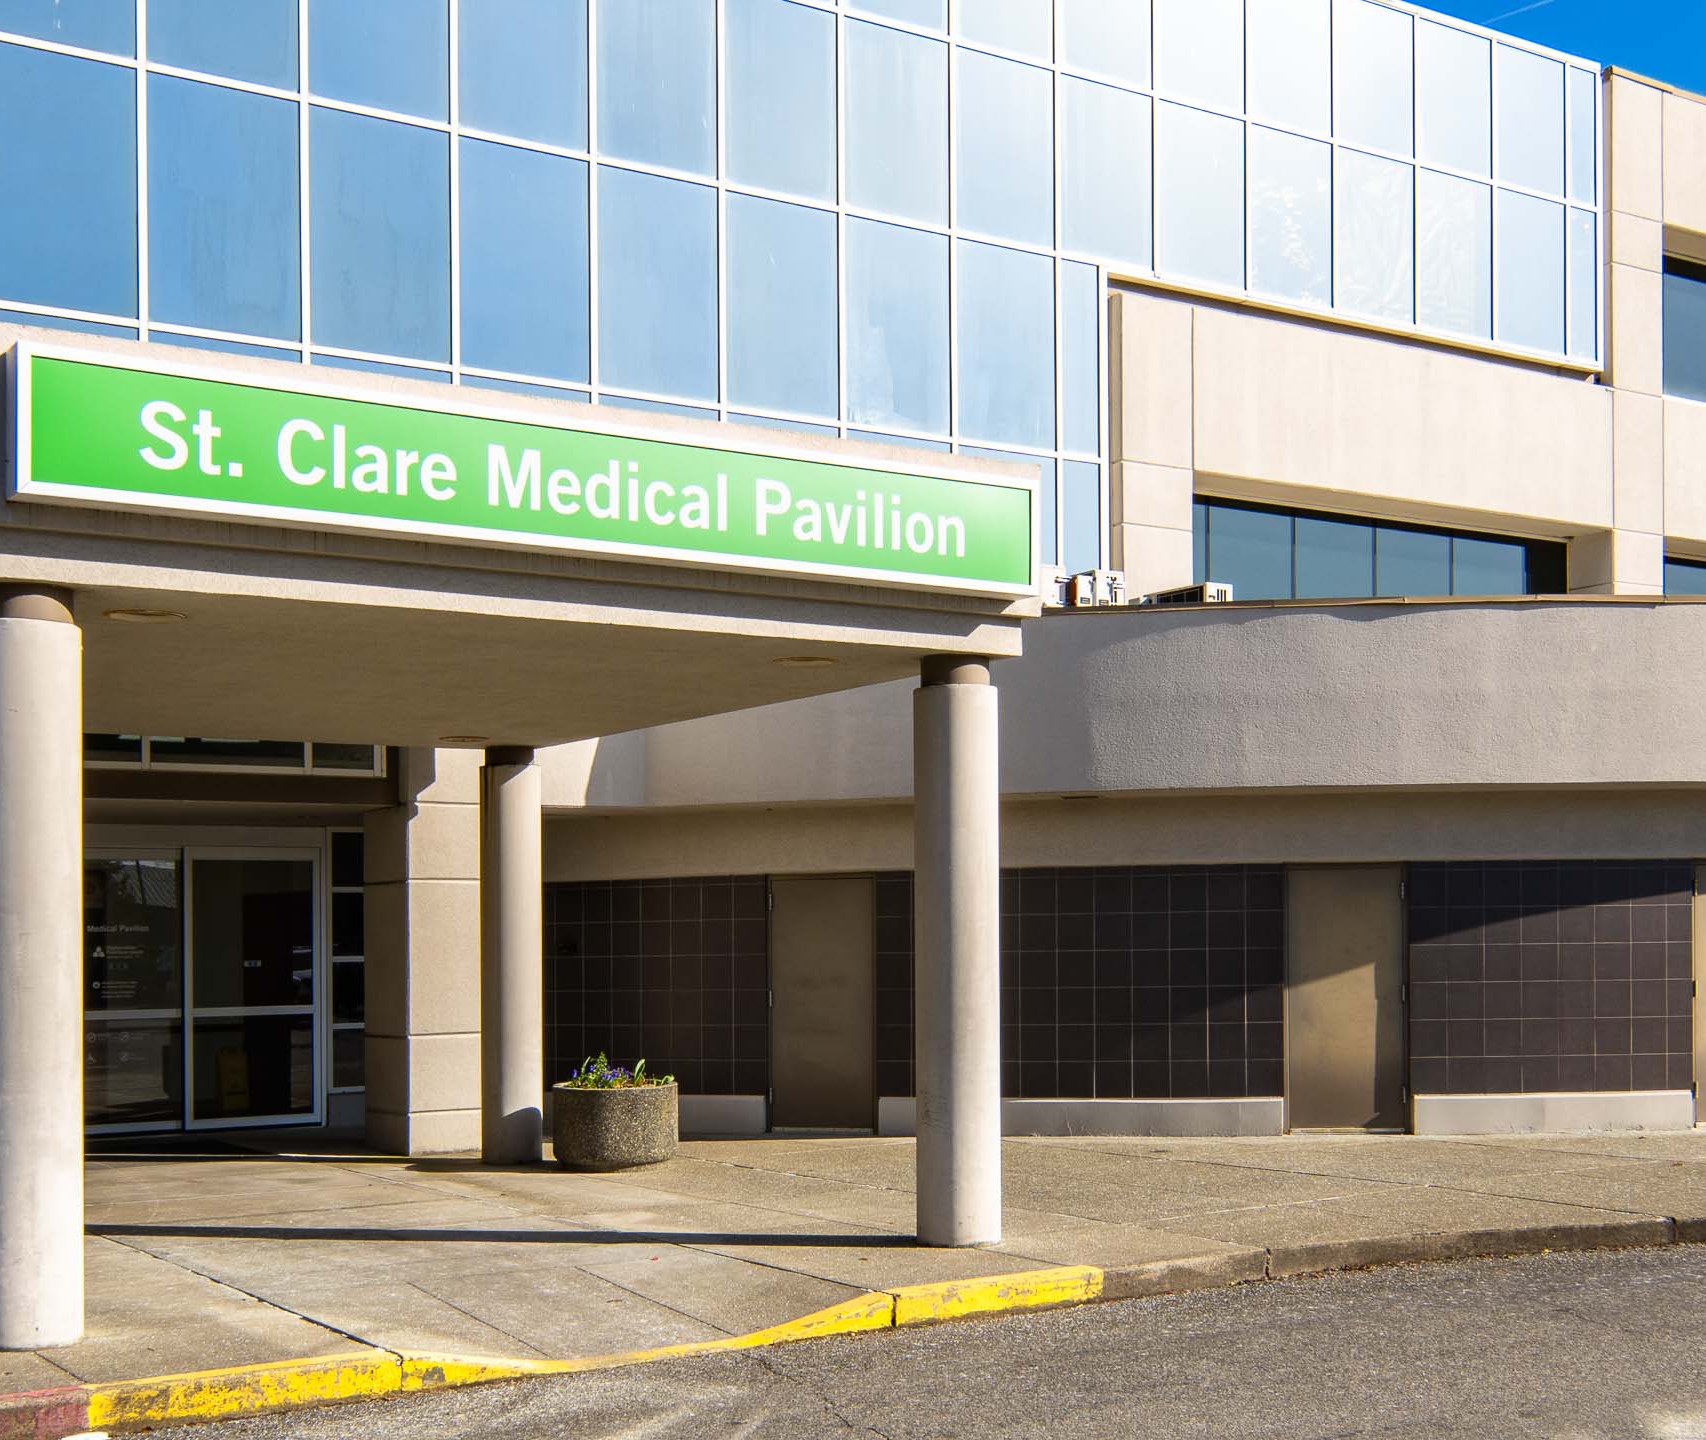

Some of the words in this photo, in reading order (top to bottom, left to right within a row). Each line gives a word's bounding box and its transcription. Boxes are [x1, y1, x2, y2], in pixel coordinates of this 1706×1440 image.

[138, 400, 243, 478] St.
[276, 418, 457, 501] Clare
[486, 443, 729, 532] Medical
[753, 476, 966, 558] Pavilion
